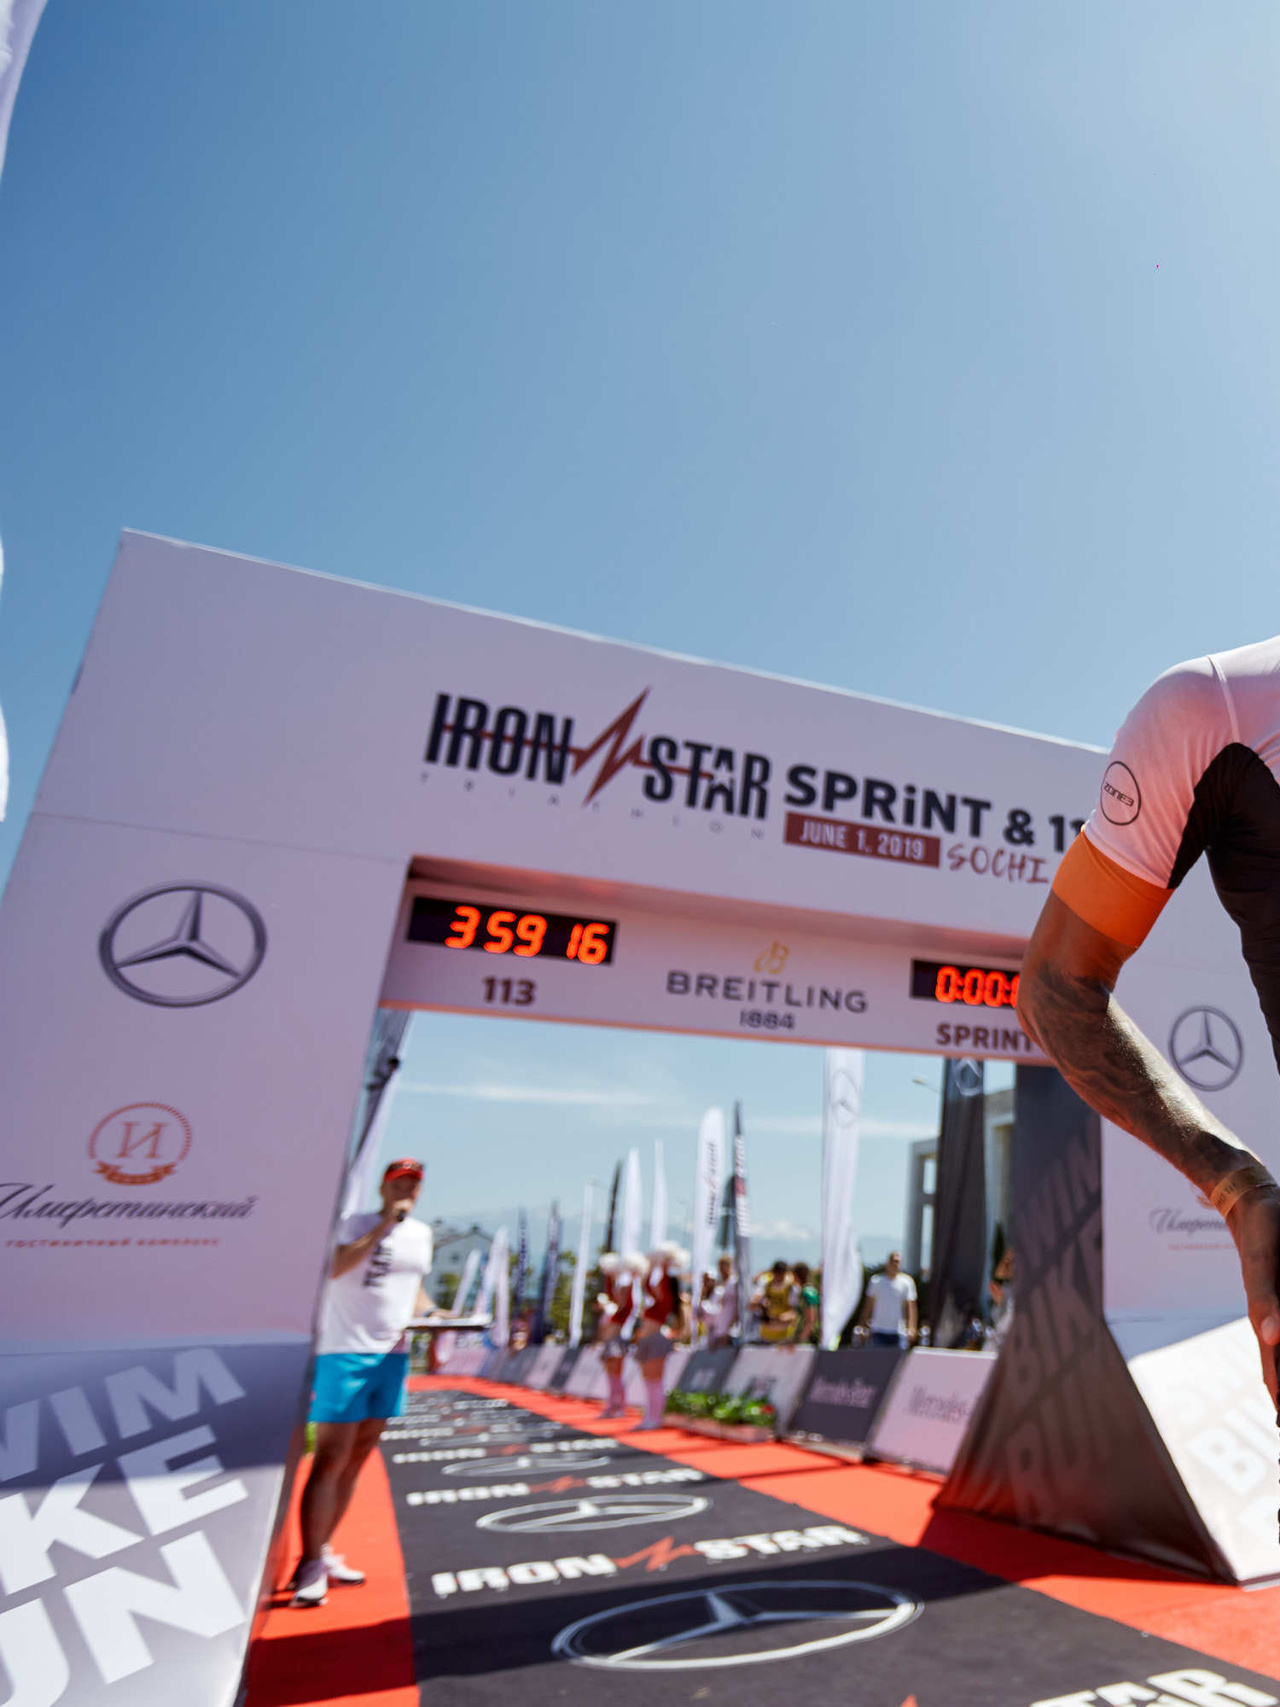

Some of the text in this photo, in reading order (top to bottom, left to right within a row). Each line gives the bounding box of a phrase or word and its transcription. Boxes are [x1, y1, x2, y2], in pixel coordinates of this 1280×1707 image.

[425, 692, 771, 820] IRON STAR
[799, 820, 848, 849] JUNE
[876, 834, 926, 861] 2019
[1003, 808, 1036, 847] &
[946, 842, 1049, 884] SOCHI
[482, 975, 538, 1006] 113
[666, 970, 869, 1014] BREITLING
[739, 1009, 795, 1031] 1884
[936, 1021, 1032, 1053] SPRINT
[432, 1524, 869, 1596] IRON STAR
